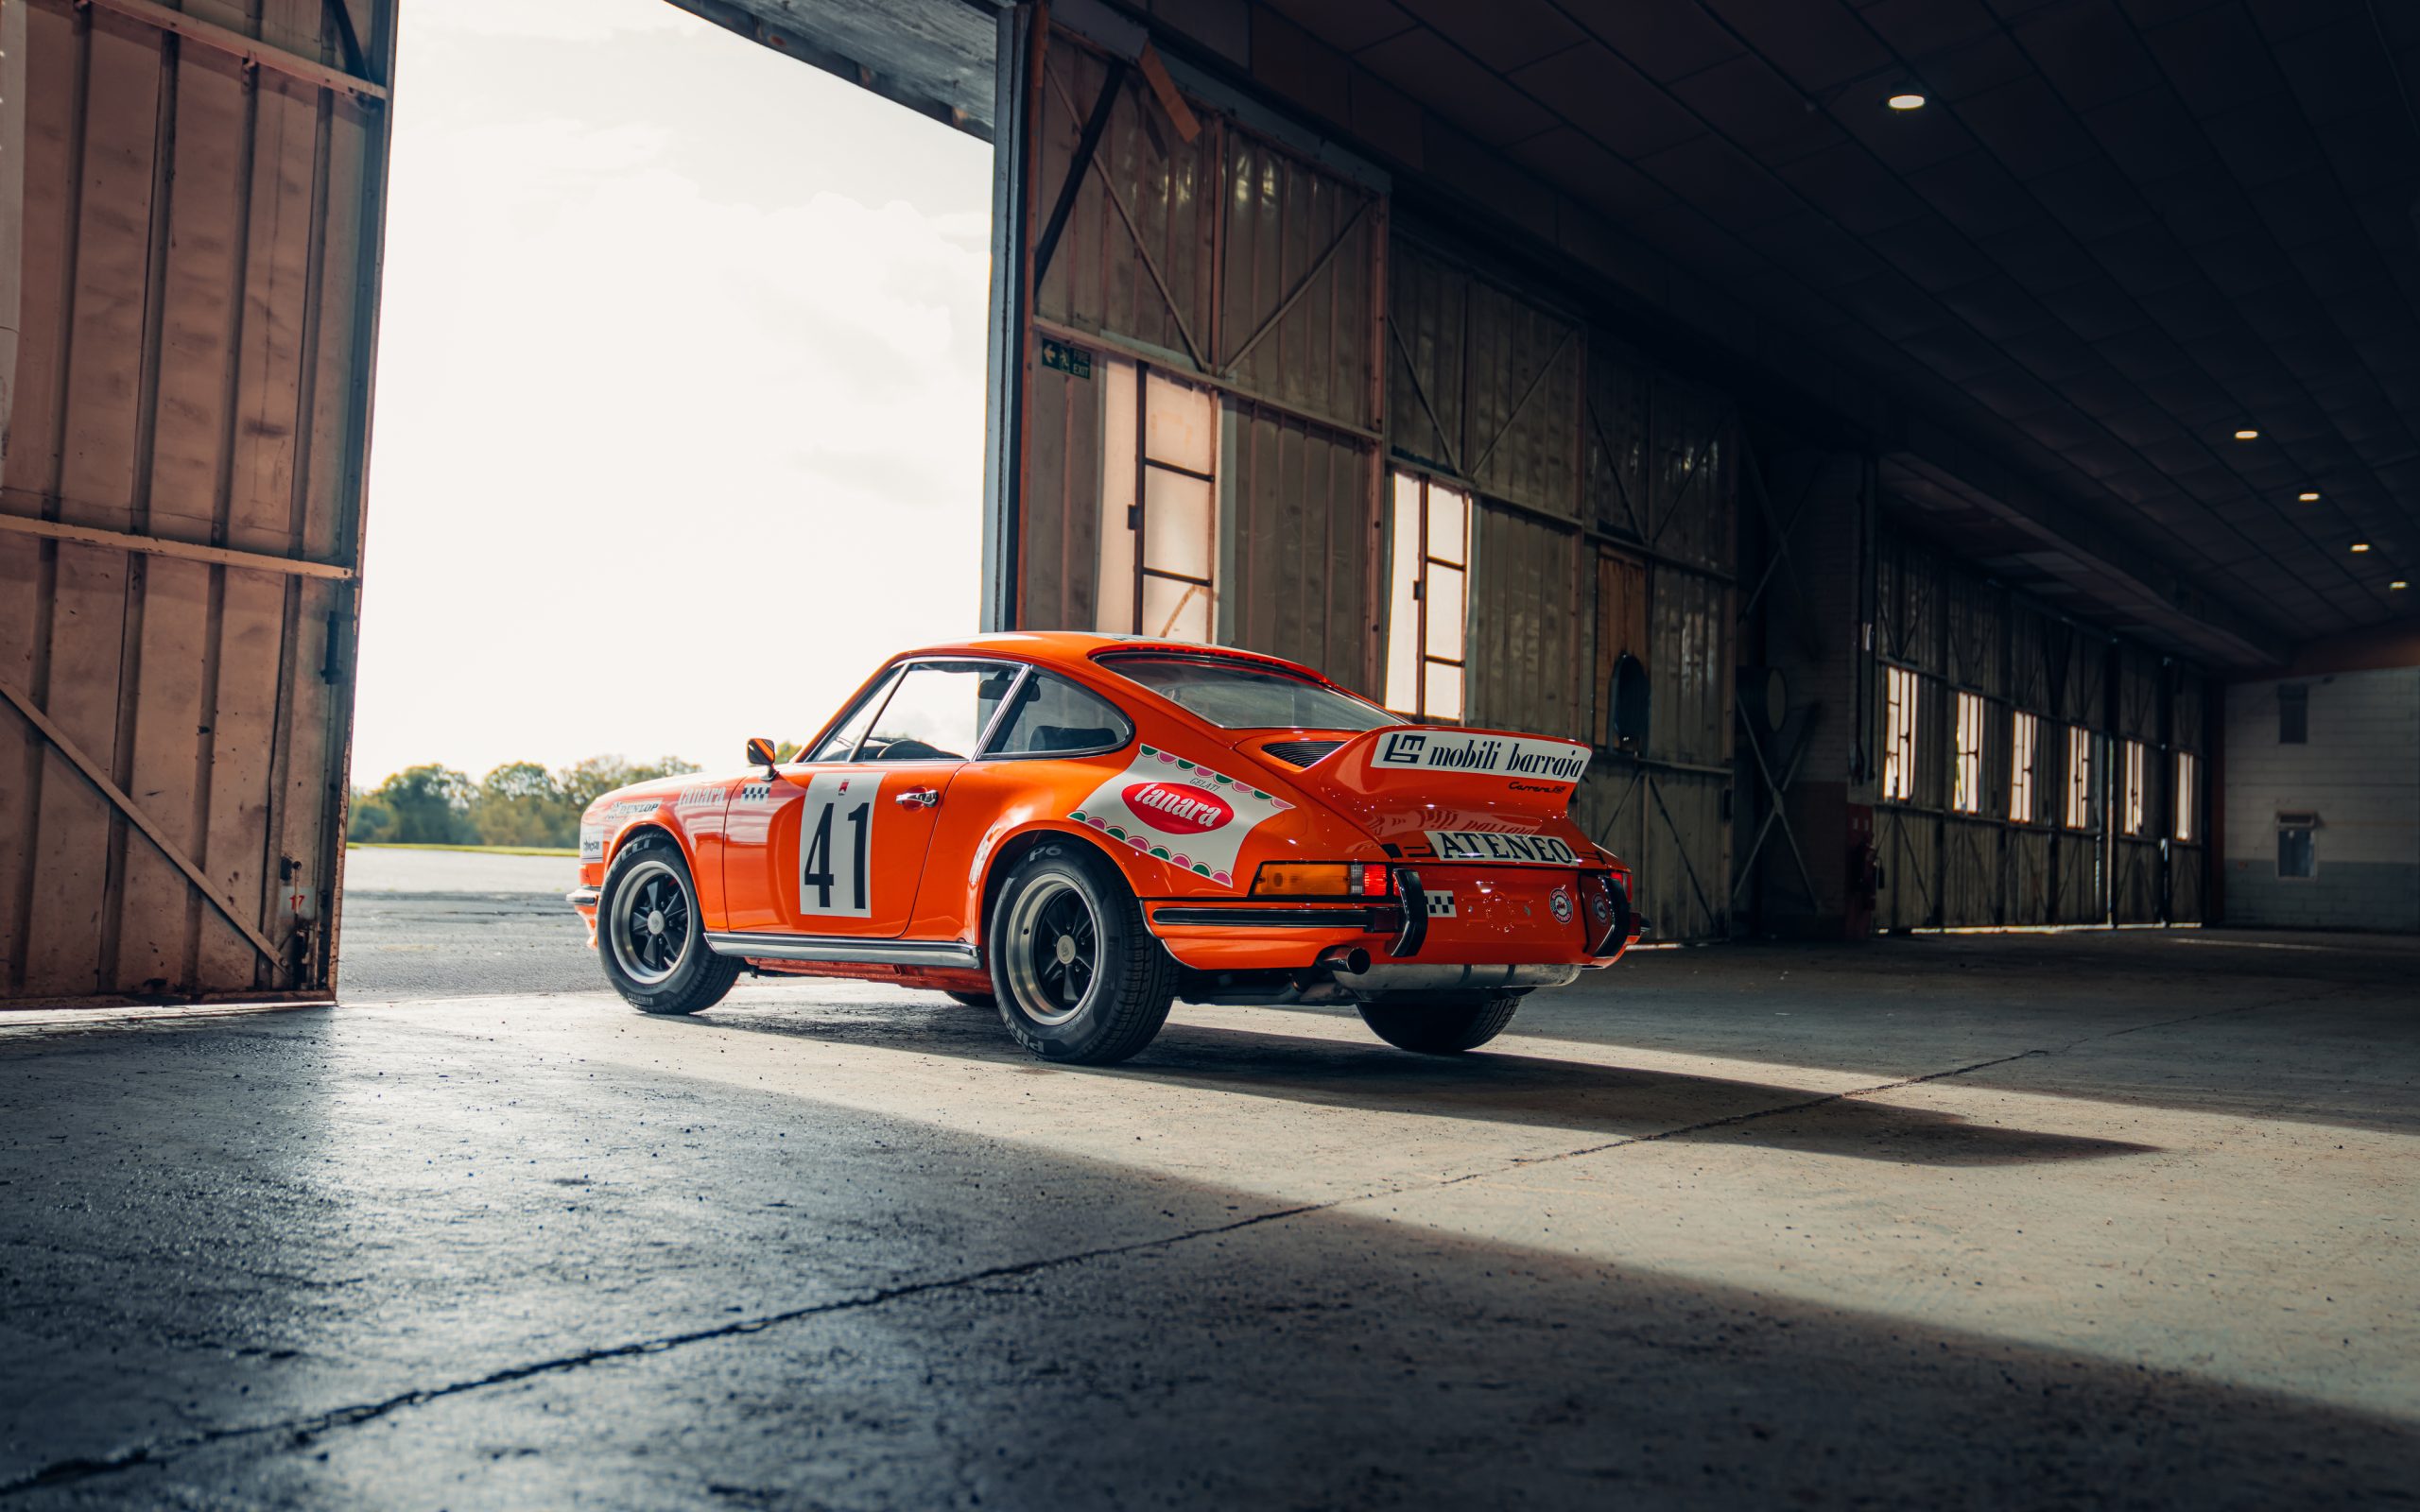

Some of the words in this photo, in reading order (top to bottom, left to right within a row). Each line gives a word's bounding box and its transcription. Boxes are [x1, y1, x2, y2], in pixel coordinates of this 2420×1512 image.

[1073, 349, 1090, 364] FIRE
[1073, 364, 1090, 377] EXIT
[1427, 739, 1501, 769] mobili
[1505, 743, 1583, 779] barraja
[1189, 777, 1220, 792] GELATI
[1509, 781, 1552, 793] Carrera
[1133, 782, 1222, 827] tanara
[804, 802, 870, 909] 41
[1028, 845, 1063, 862] P6
[1437, 832, 1573, 864] ATENEO
[289, 894, 305, 911] 17
